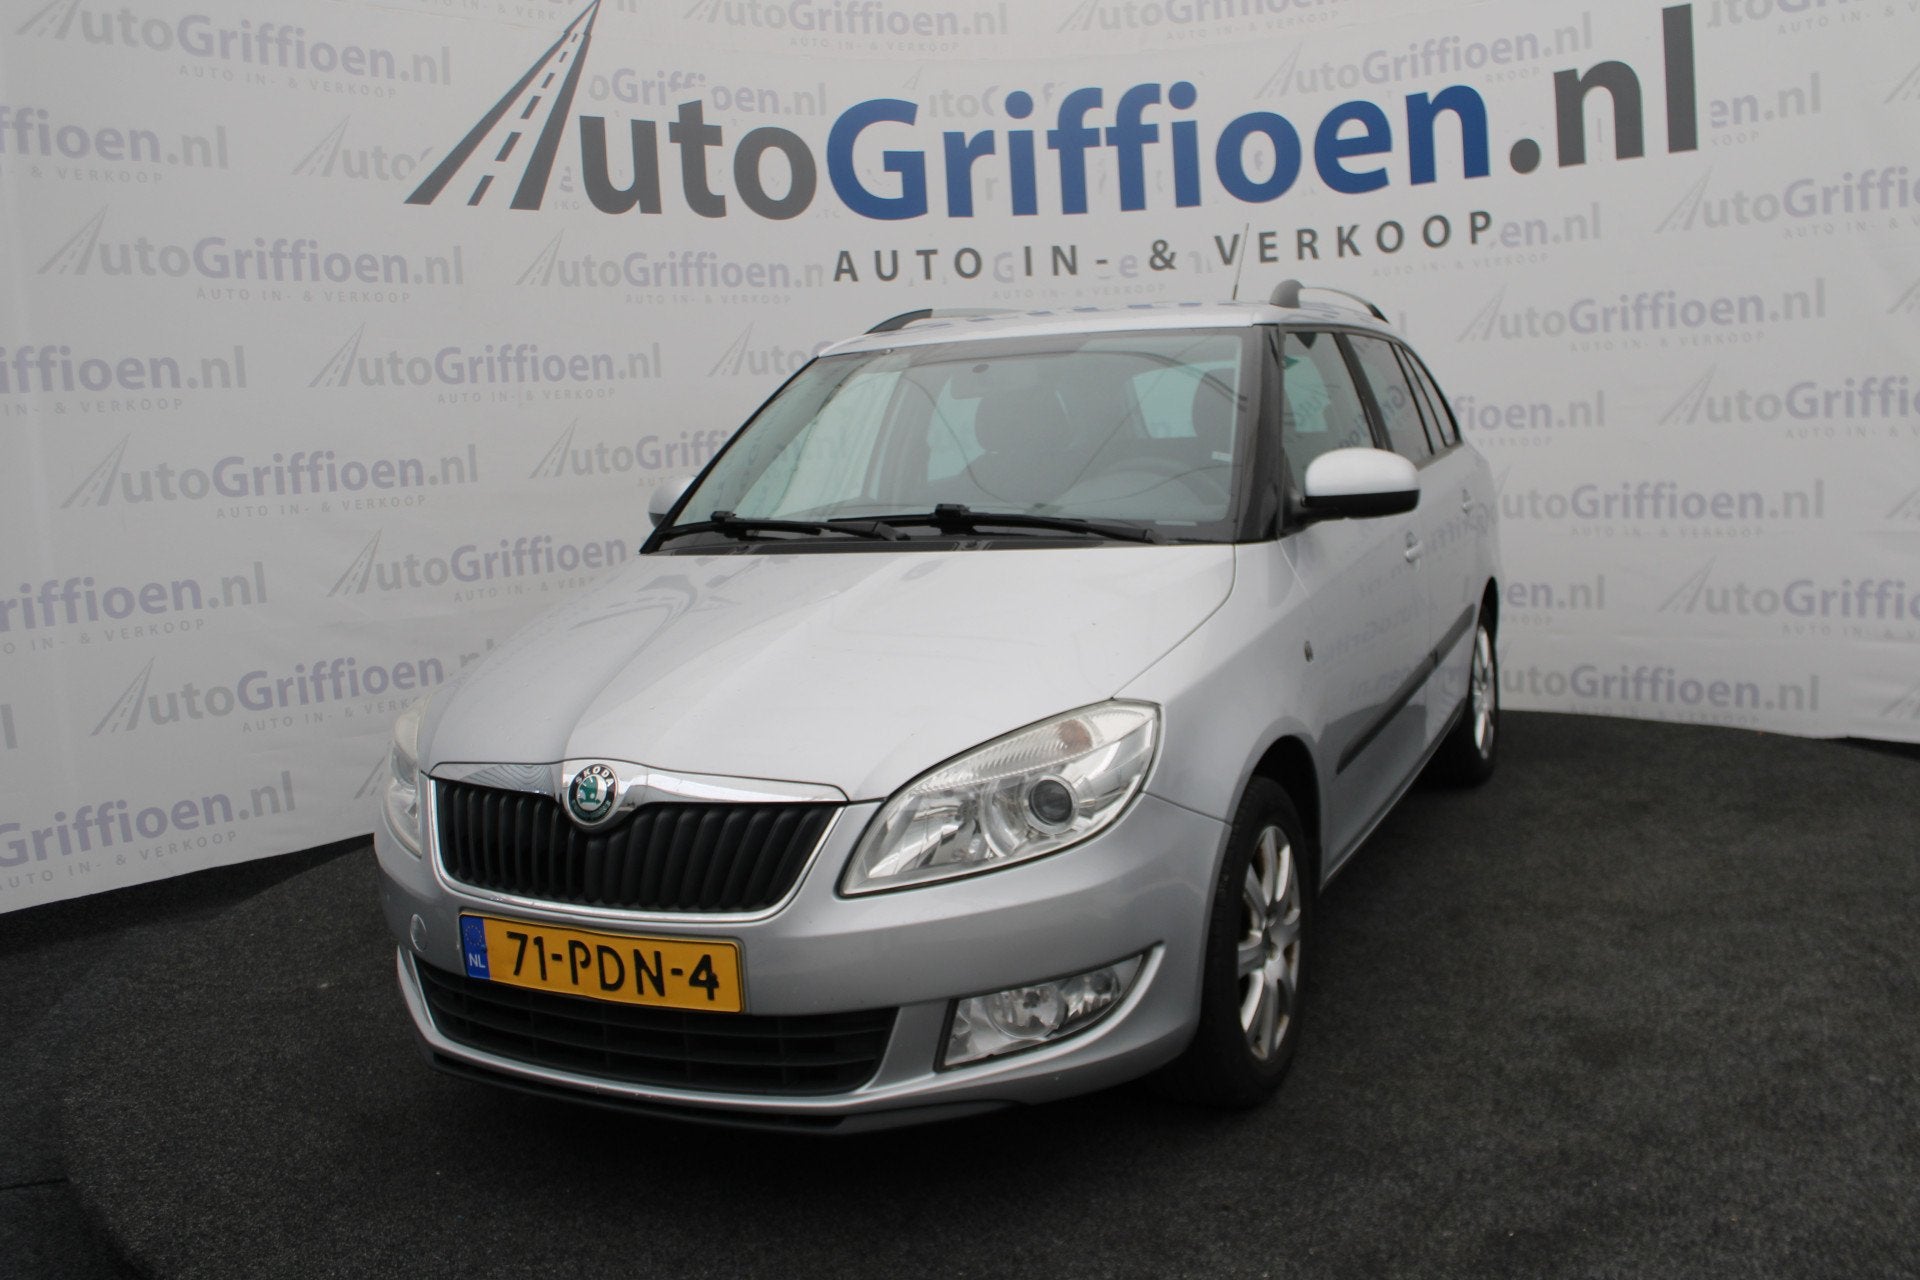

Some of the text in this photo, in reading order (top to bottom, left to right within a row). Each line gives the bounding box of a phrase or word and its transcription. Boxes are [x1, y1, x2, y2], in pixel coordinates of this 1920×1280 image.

[404, 0, 1698, 220] AutoGriffioen.nl
[1654, 163, 1920, 234] AutoGriffi
[512, 228, 824, 288] AutoGriffioen.n
[833, 247, 983, 281] AUTO
[1149, 239, 1177, 271] &
[1214, 210, 1493, 266] VERKOOP
[196, 288, 250, 301] AUTO
[323, 290, 411, 303] VERKOOP
[1657, 362, 1920, 426] AutoGriffi
[216, 505, 269, 520] AUTO
[342, 494, 426, 511] VERKOOP
[326, 528, 627, 597] AutoGriffioen
[104, 618, 206, 643] VERKOOP
[0, 870, 54, 891] UTO
[139, 831, 237, 861] VERKOOP
[468, 953, 486, 969] NL
[506, 930, 720, 1001] 71-PDN-4
